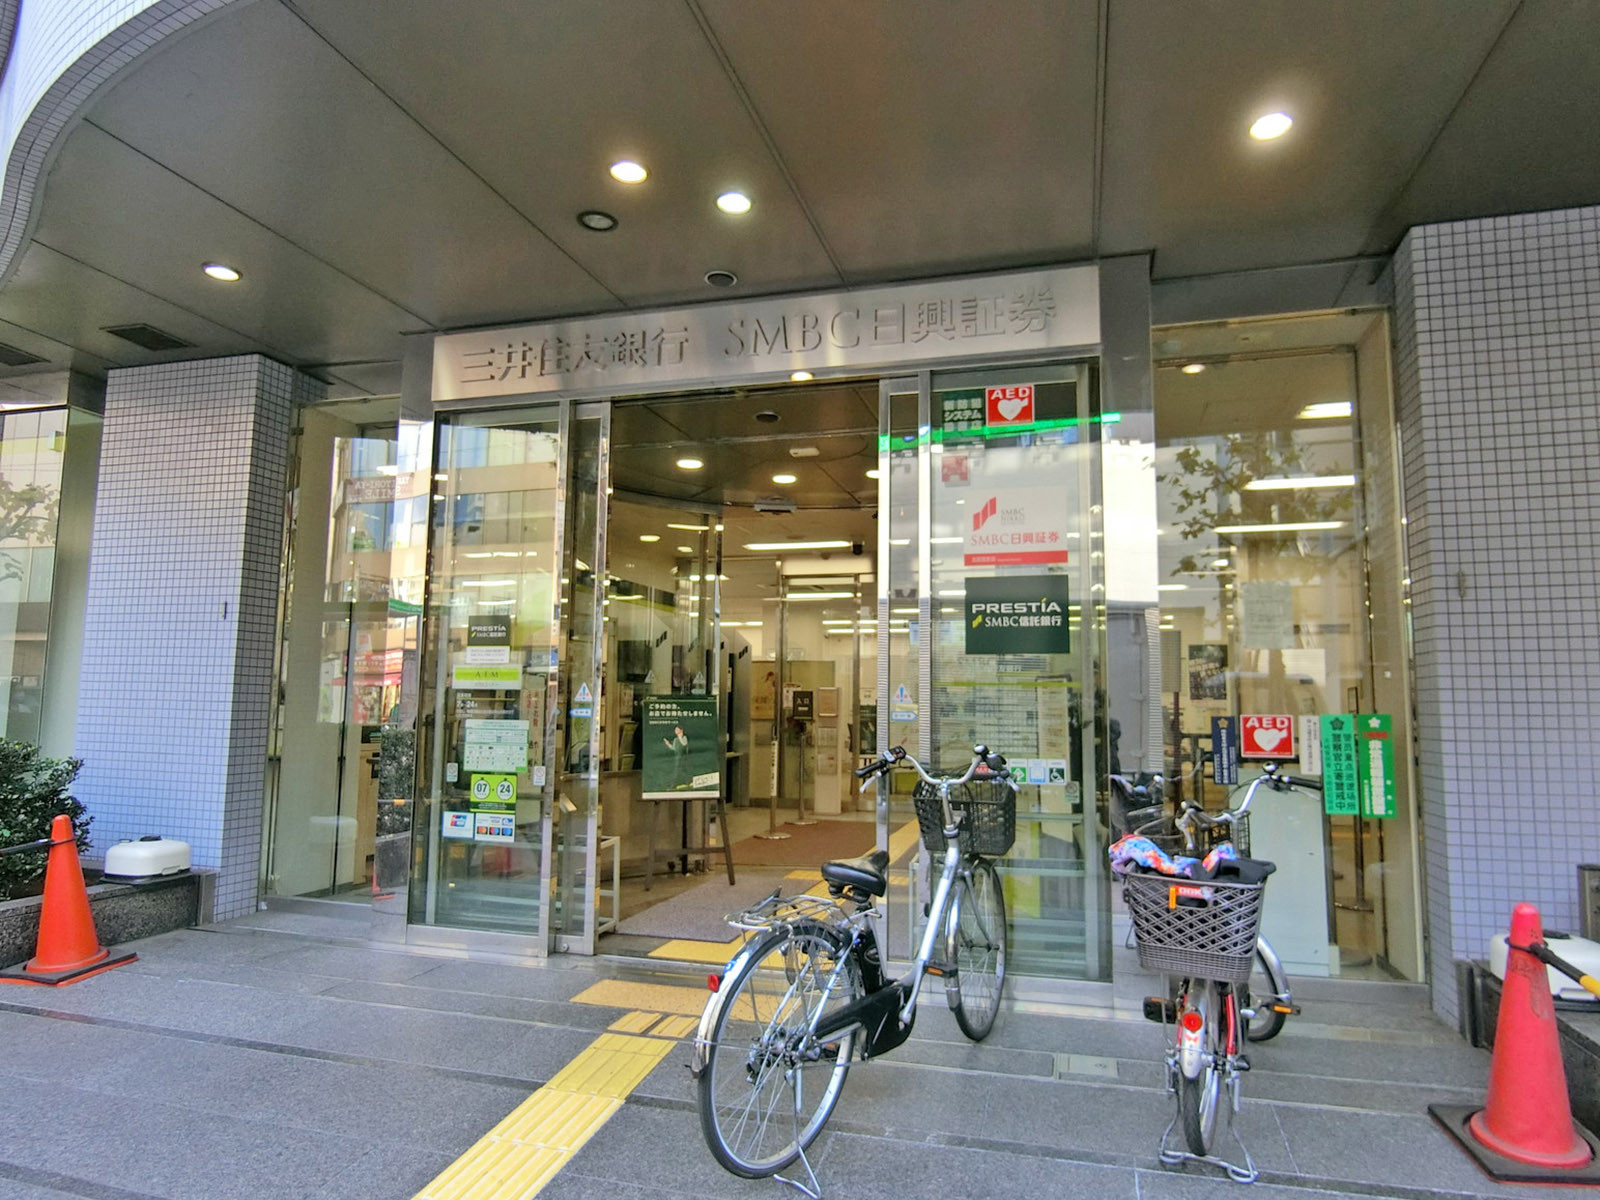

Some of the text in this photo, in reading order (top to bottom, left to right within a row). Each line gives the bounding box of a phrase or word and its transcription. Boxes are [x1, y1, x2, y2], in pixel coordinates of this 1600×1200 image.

[460, 288, 1057, 384] 三井住友銀行 SMBC日興証券
[991, 386, 1030, 400] AED
[944, 408, 982, 422] システム
[970, 531, 1060, 546] SMBC日興証券
[984, 615, 1062, 628] SMBC信託銀行
[1246, 716, 1289, 728] AED
[476, 783, 511, 794] 07 24
